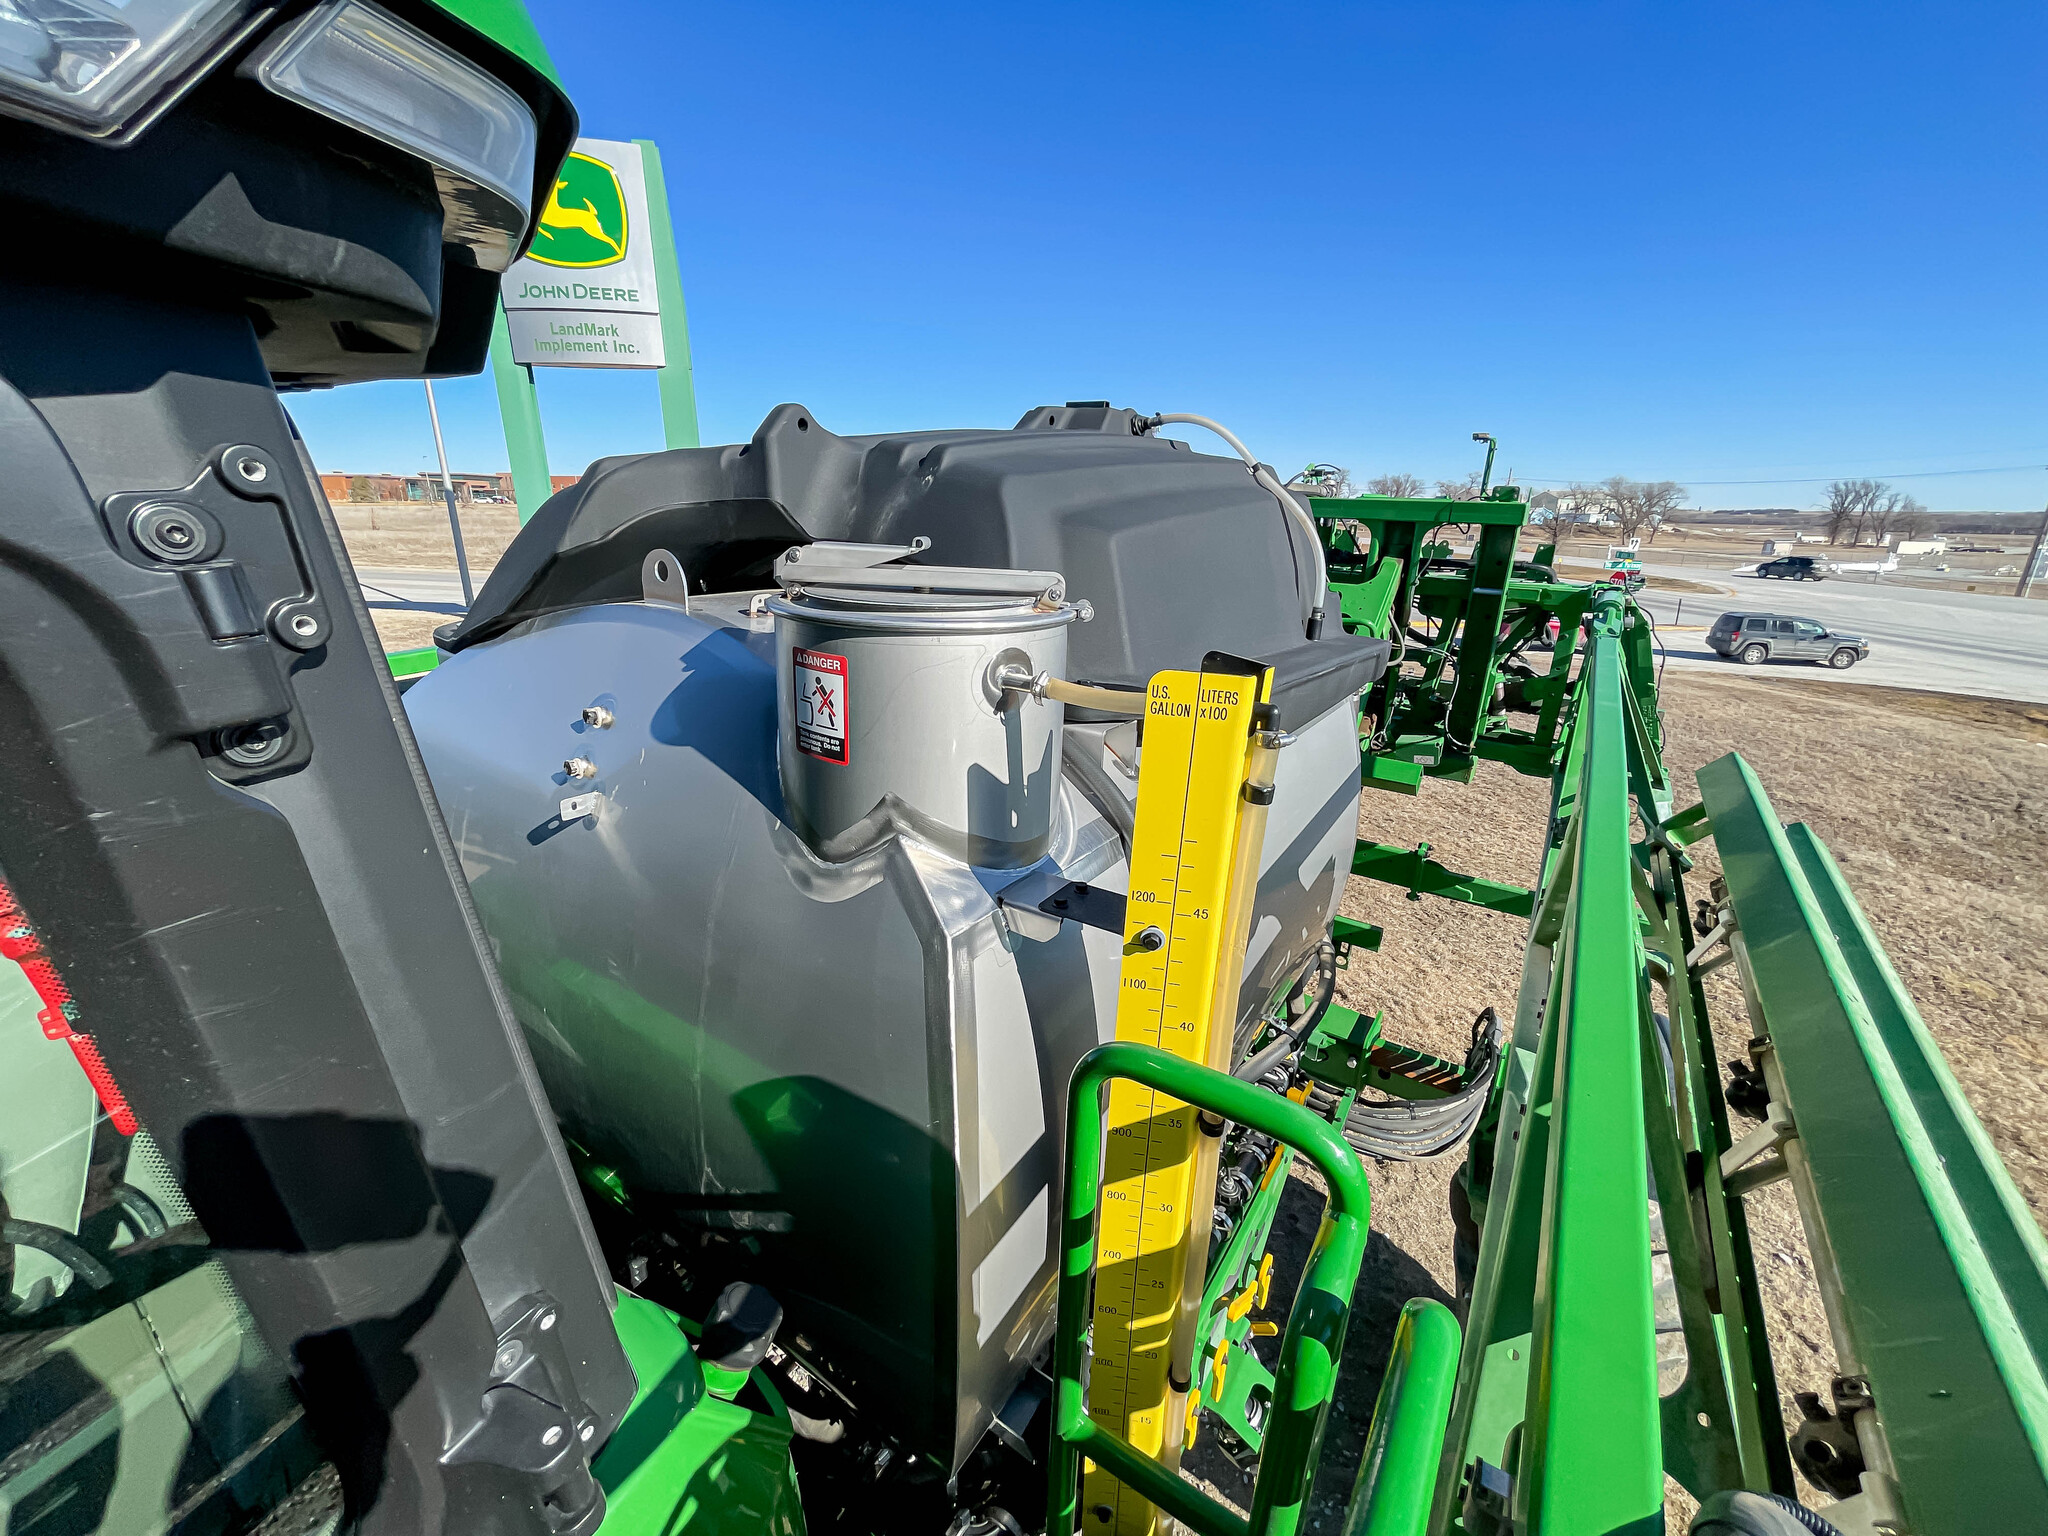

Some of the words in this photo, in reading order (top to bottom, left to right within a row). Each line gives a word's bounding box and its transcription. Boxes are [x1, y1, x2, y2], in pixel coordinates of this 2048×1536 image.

[519, 283, 569, 299] JOHN
[573, 283, 640, 302] DEERE
[549, 322, 620, 337] LandMark
[534, 338, 608, 354] Implement
[613, 340, 640, 353] Inc.
[803, 654, 841, 671] DANGER
[1151, 684, 1171, 700] U.S.
[1201, 688, 1239, 706] LITERS
[1150, 701, 1191, 718] GALLON
[1199, 706, 1228, 720] x100
[830, 738, 840, 746] are
[831, 744, 841, 752] not
[1131, 890, 1156, 903] 1200
[1193, 908, 1209, 919] 45
[1122, 978, 1147, 990] 1100
[1179, 1022, 1195, 1033] 40
[1168, 1118, 1182, 1129] 35
[1111, 1126, 1132, 1138] 900
[1106, 1190, 1127, 1201] 800
[1158, 1203, 1173, 1213] 30
[1102, 1249, 1122, 1260] 700
[1151, 1279, 1165, 1289] 25
[1098, 1305, 1118, 1315] 600
[1144, 1350, 1158, 1360] 20
[1095, 1357, 1113, 1367] 500
[1140, 1416, 1152, 1425] 15
